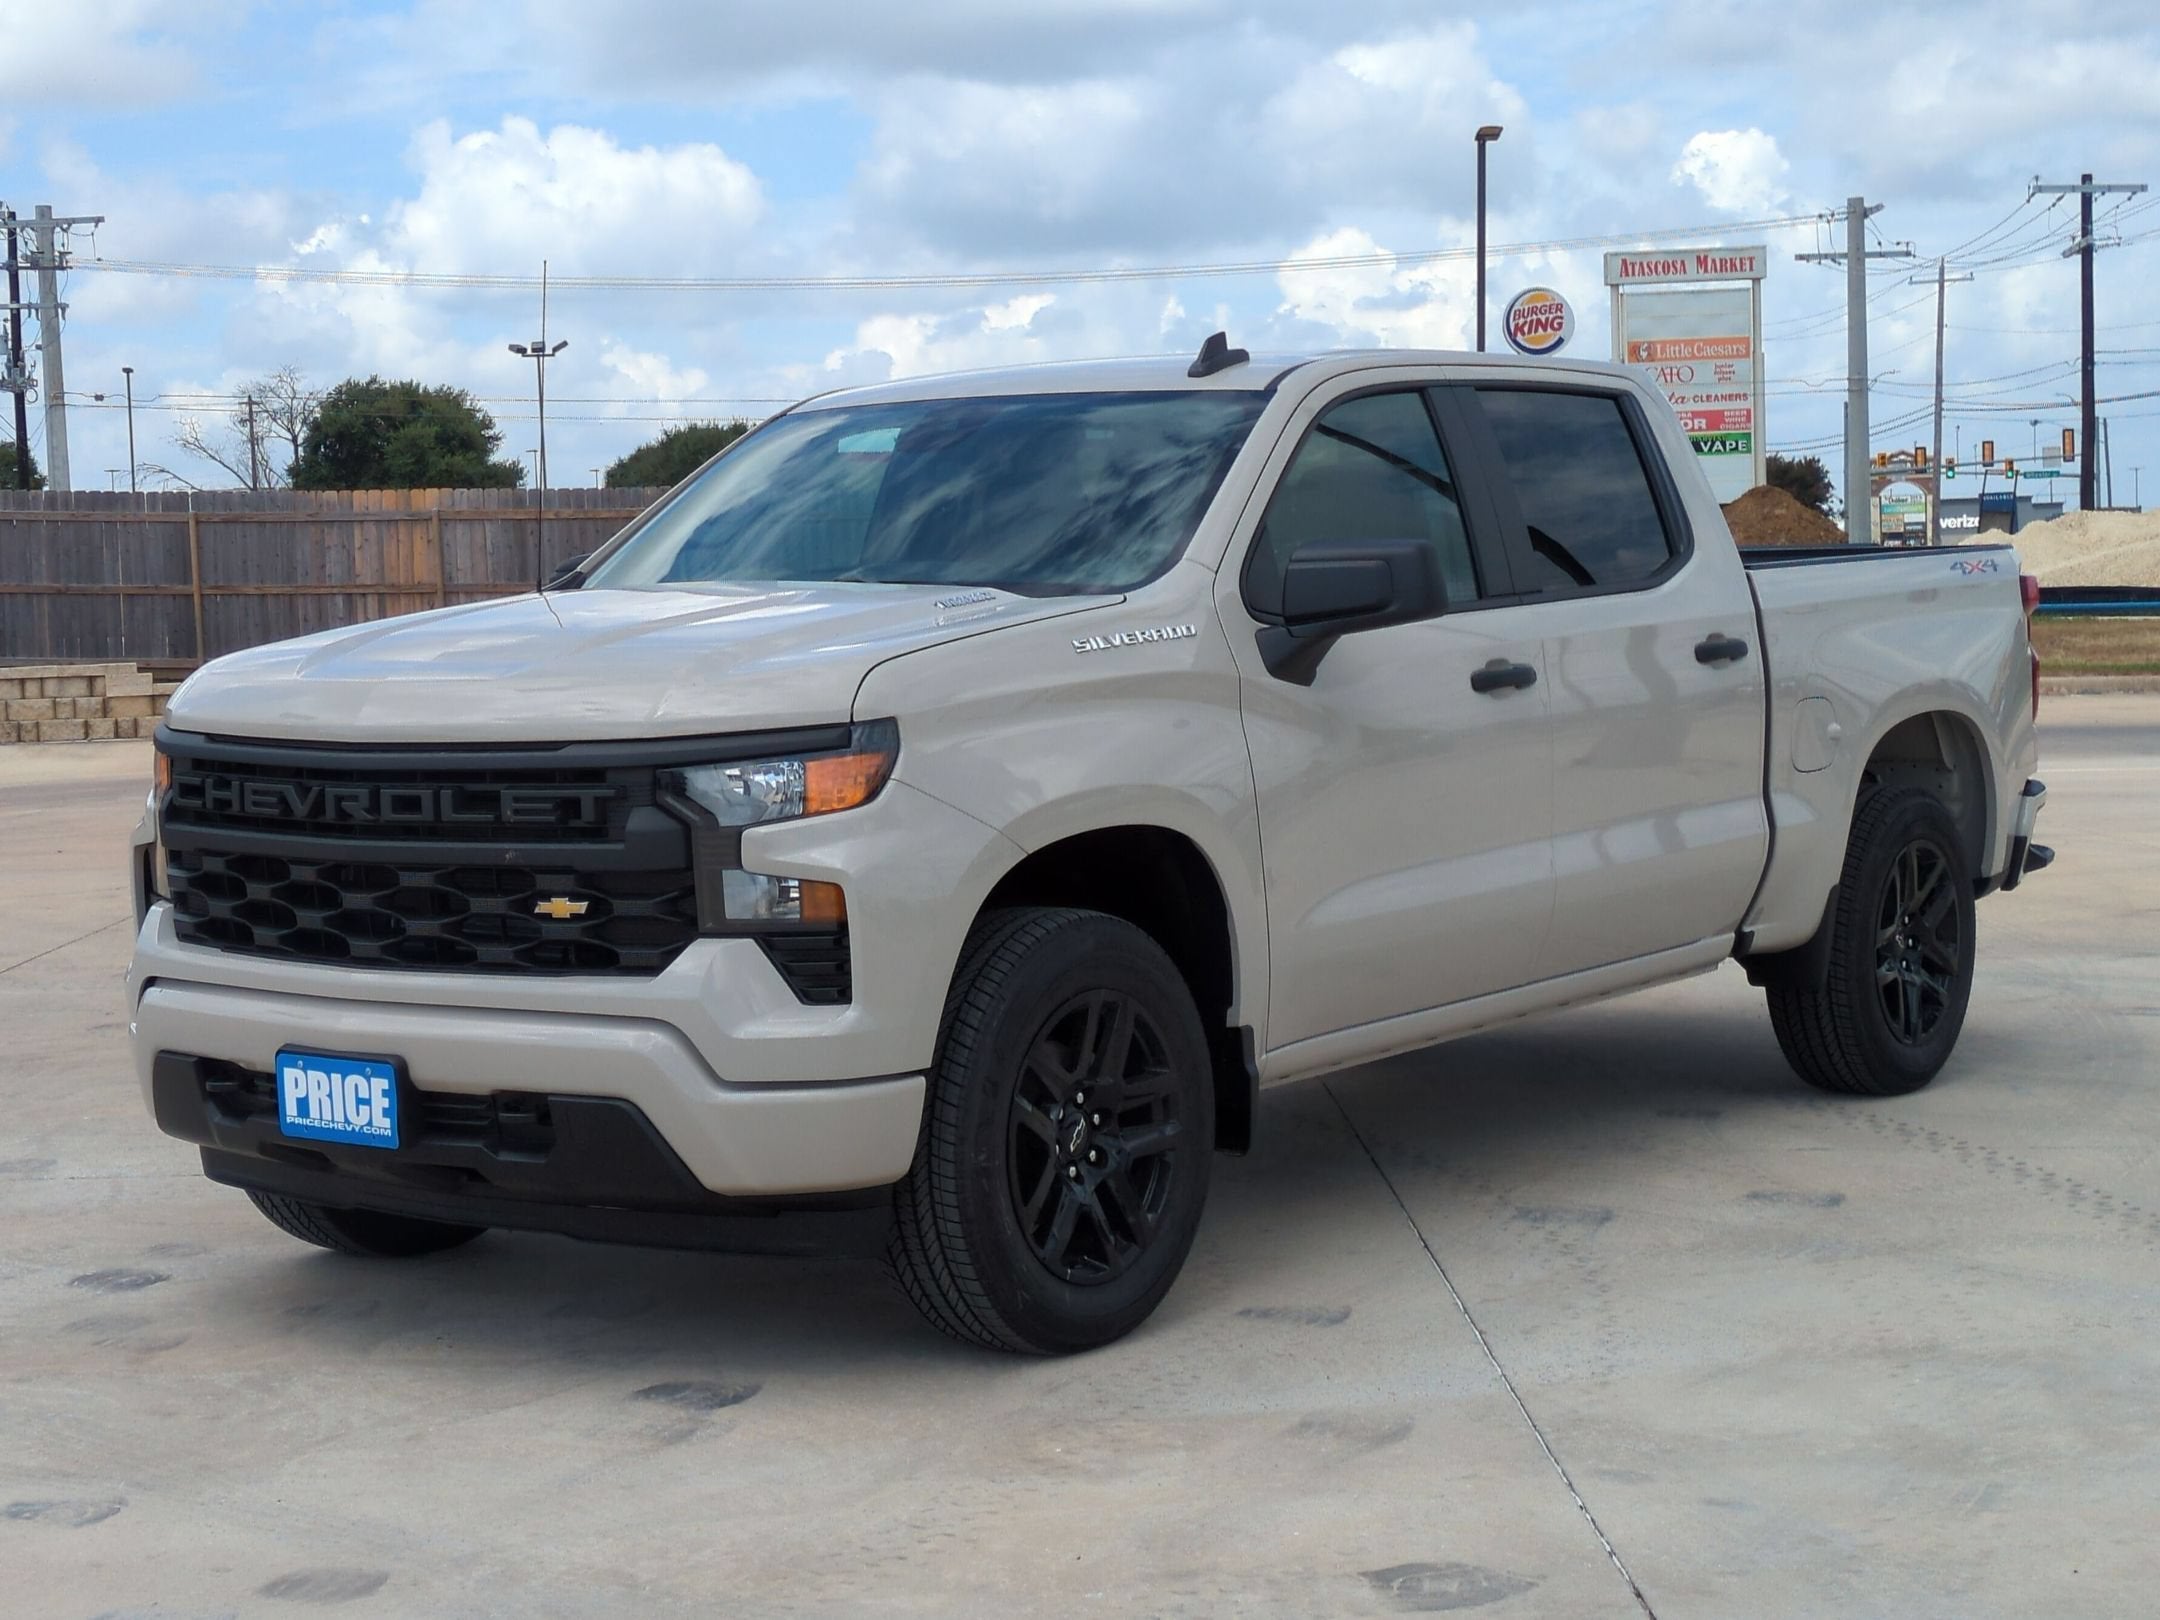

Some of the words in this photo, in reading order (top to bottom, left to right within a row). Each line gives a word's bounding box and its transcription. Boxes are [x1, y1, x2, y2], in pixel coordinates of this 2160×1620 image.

[1619, 258, 1687, 278] ATASCOSA
[1696, 254, 1756, 274] MARKET
[1513, 303, 1564, 321] BURGER
[1513, 315, 1564, 338] KING
[1656, 344, 1692, 358] Little
[1694, 341, 1746, 357] Caesars
[1693, 393, 1749, 403] CLEANERS
[1700, 440, 1748, 453] VAPE
[1072, 624, 1197, 653] SILVERADO
[173, 775, 619, 823] CHEVROLET
[283, 1067, 391, 1129] PRICE
[286, 1116, 391, 1137] PRICECHEVY.COM
